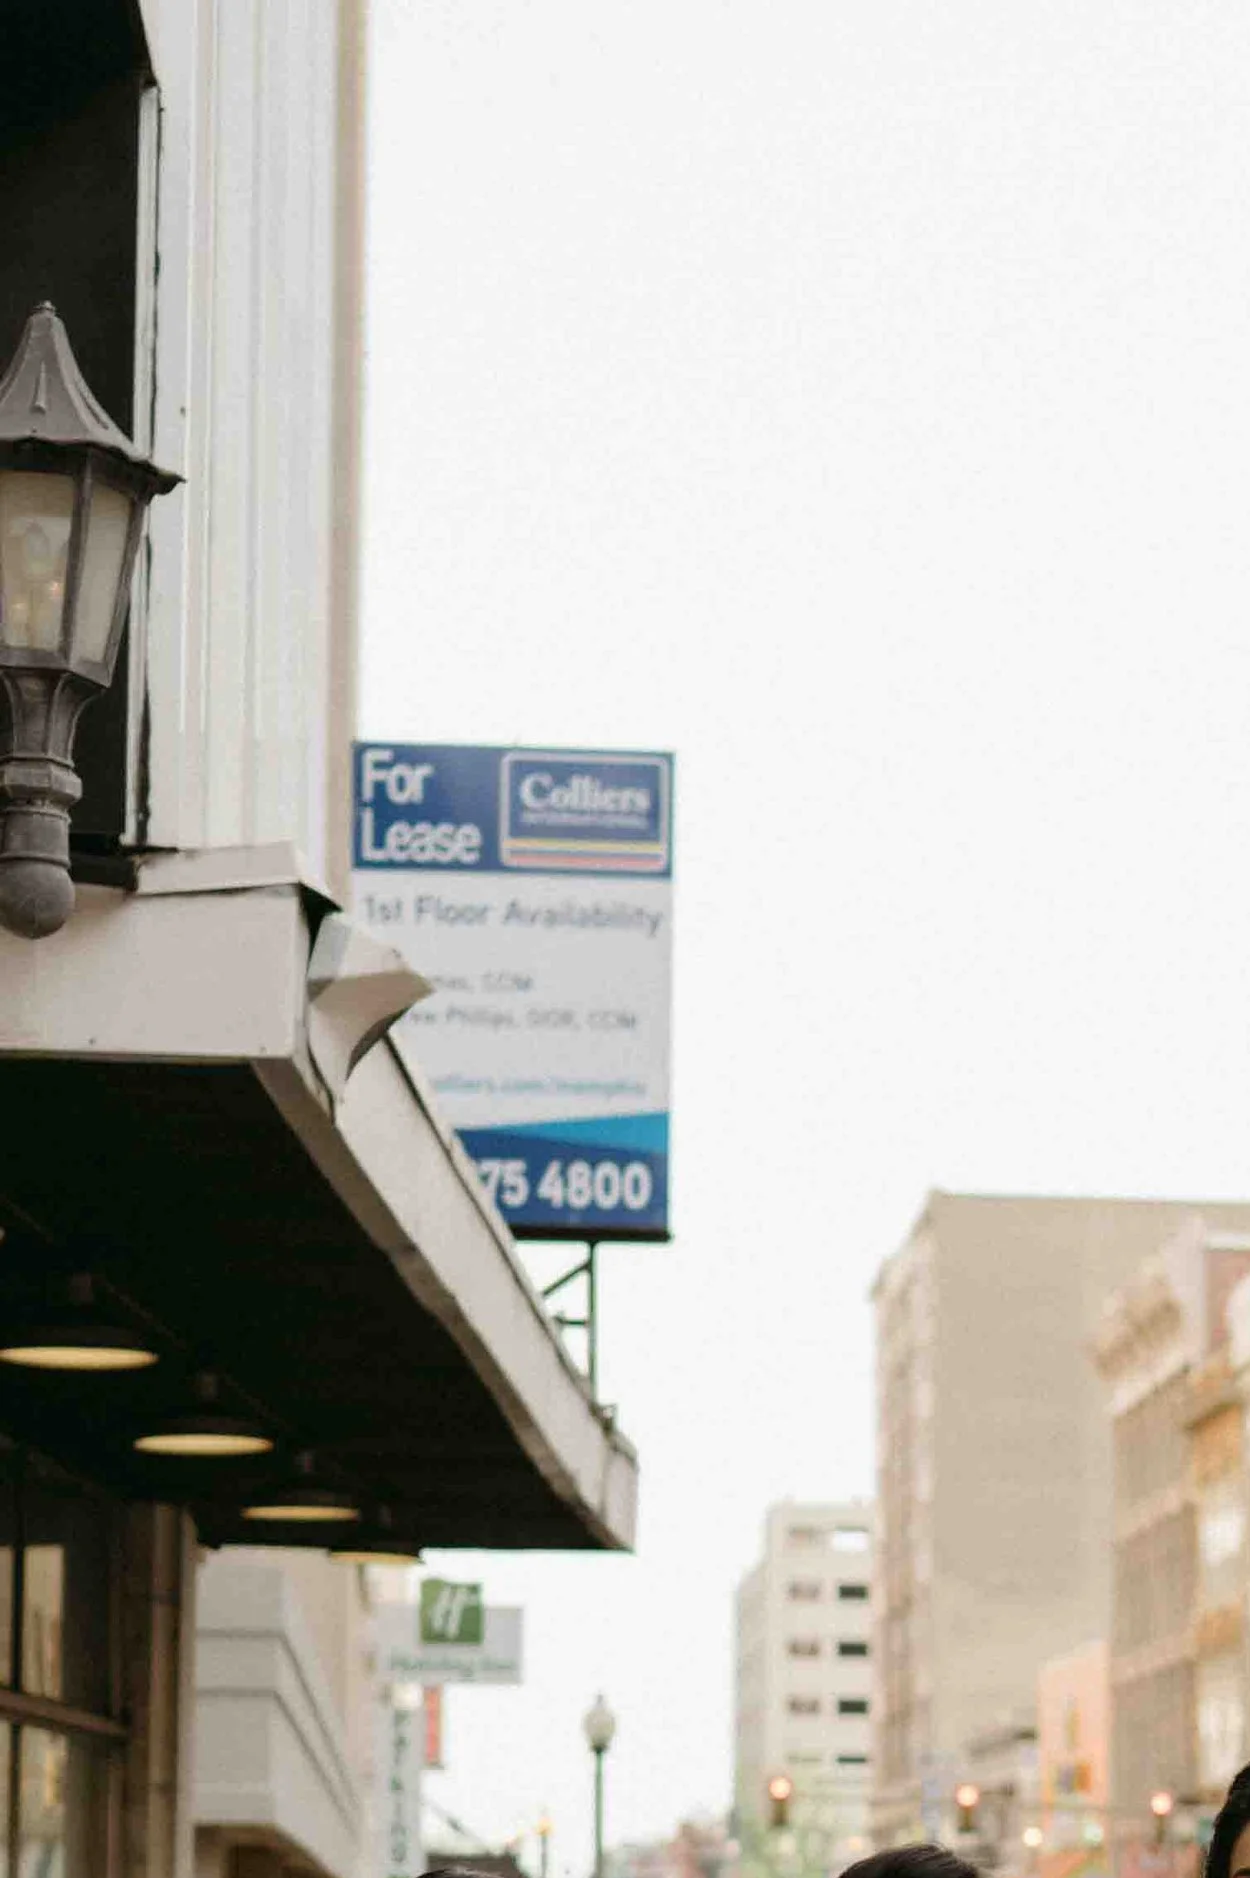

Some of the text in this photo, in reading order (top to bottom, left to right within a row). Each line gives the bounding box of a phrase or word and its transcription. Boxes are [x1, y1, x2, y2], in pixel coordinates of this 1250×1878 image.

[361, 748, 434, 804] For
[519, 772, 651, 812] Colliers
[361, 806, 482, 864] Lease
[414, 894, 491, 925] Floor
[502, 898, 665, 937] Availability
[537, 1159, 653, 1210] 4800
